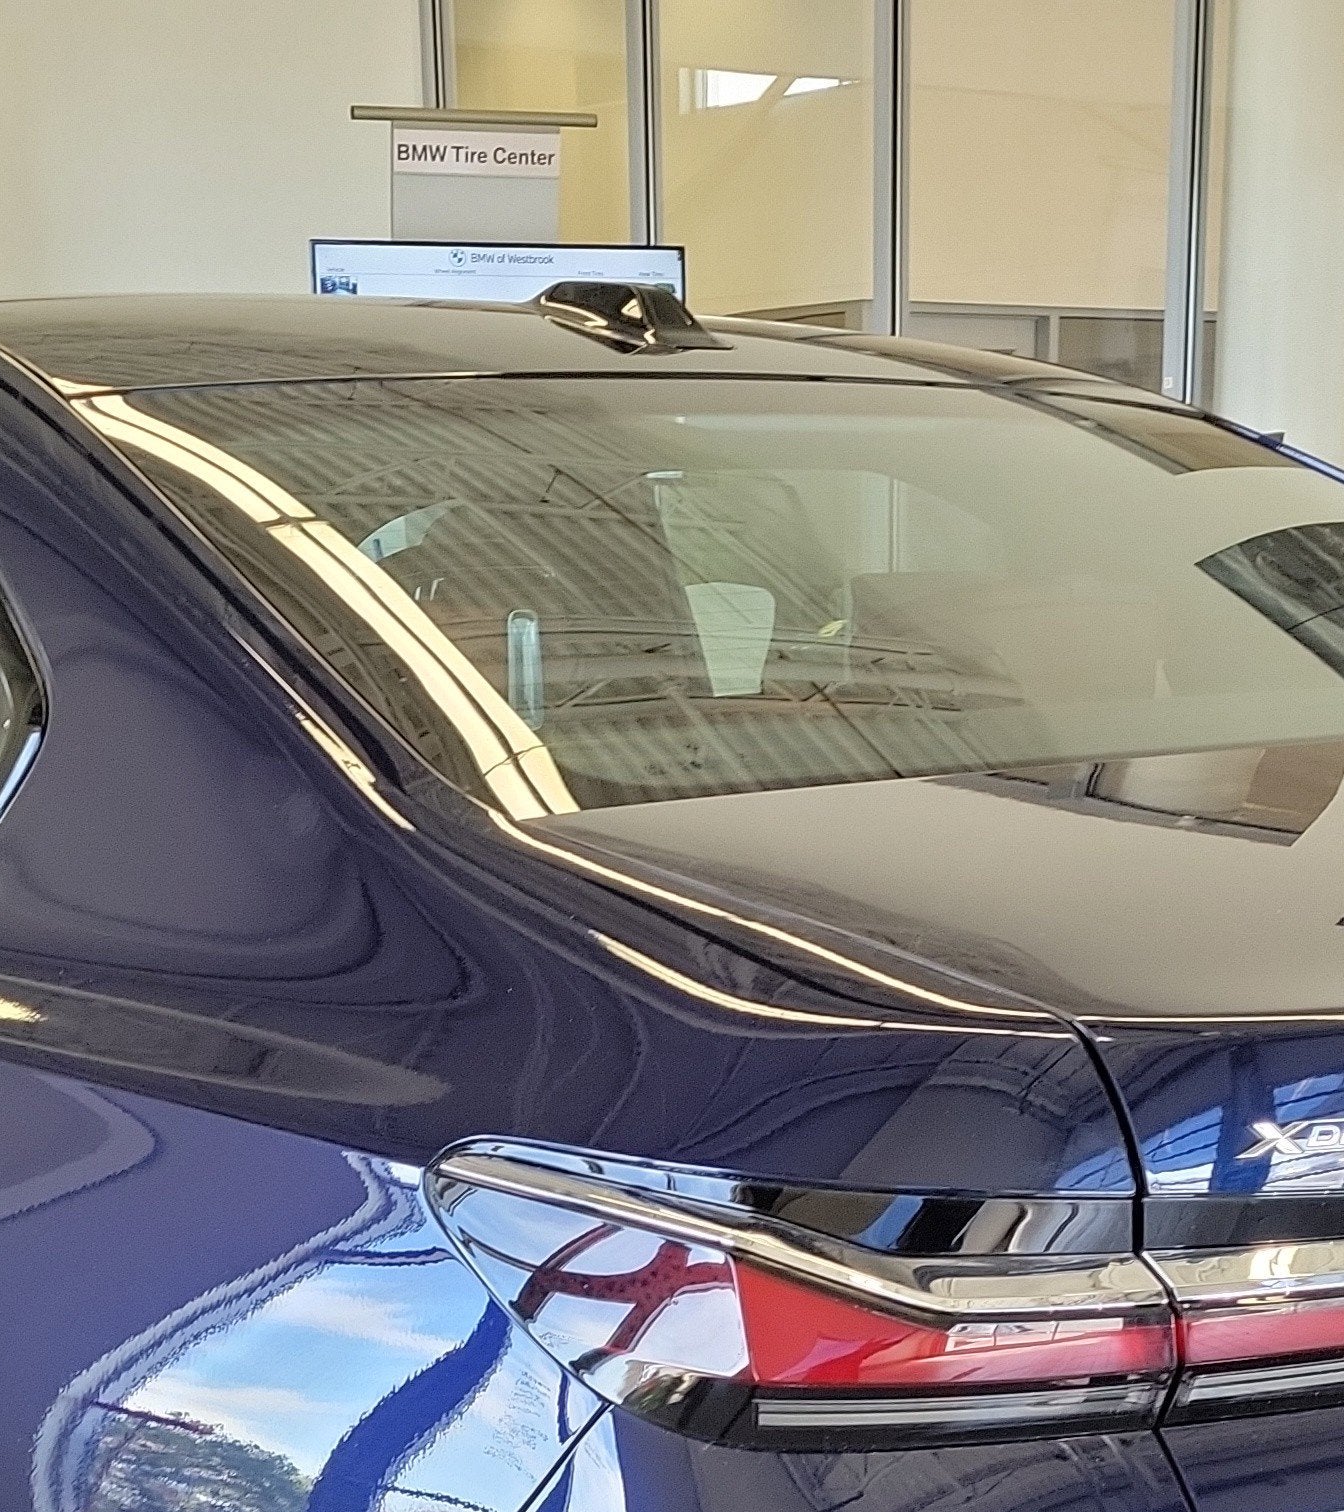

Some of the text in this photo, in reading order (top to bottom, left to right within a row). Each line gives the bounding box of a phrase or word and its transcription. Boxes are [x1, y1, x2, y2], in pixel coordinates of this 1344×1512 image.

[396, 143, 556, 167] BMW Tire Center
[471, 253, 554, 264] BMW of Westbrook
